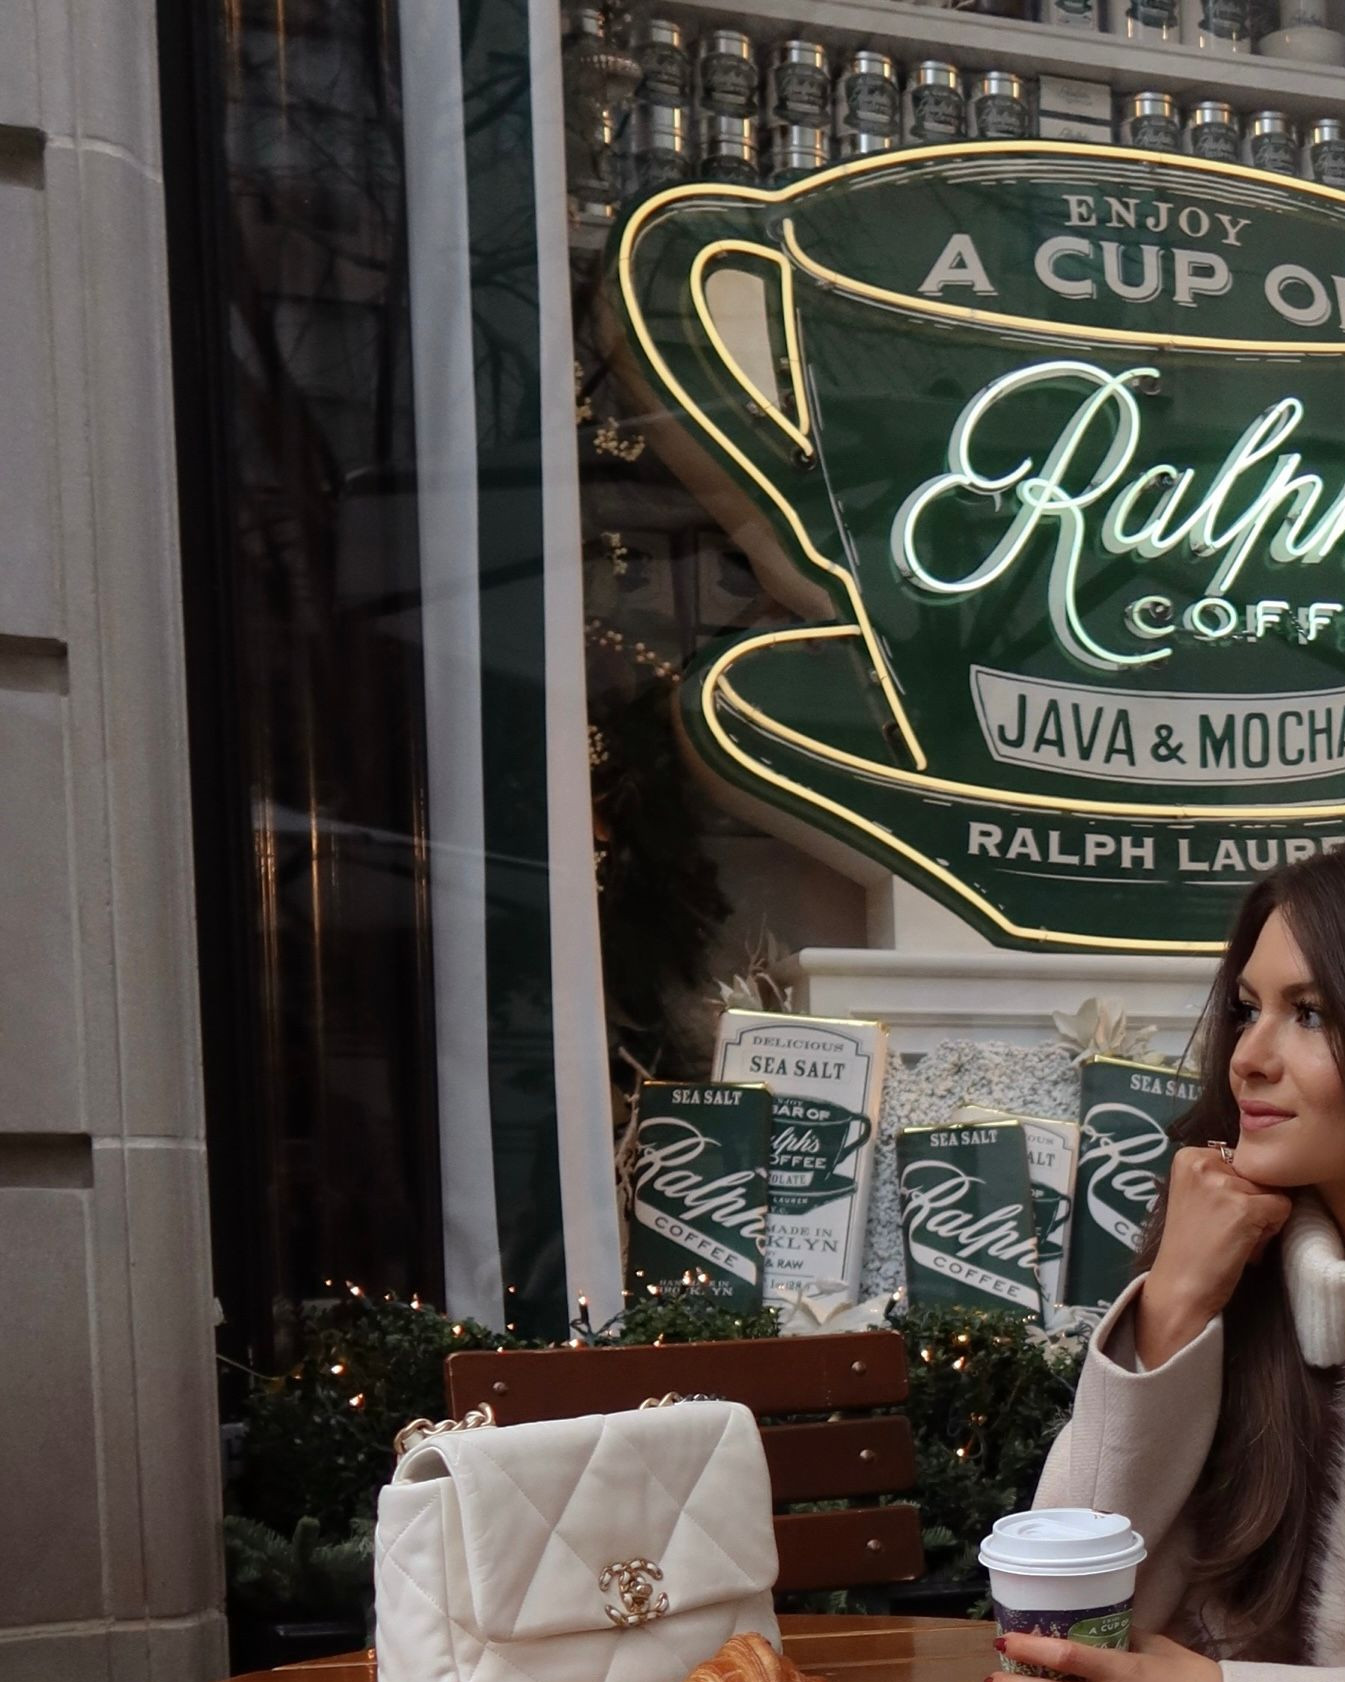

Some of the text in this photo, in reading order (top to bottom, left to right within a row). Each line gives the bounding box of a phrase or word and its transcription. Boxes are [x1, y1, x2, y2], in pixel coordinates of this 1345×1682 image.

[1061, 194, 1252, 247] ENJOY
[917, 233, 998, 297] A
[1033, 235, 1233, 308] CUP
[997, 693, 1136, 766] JAVA
[1150, 723, 1187, 765] &
[967, 821, 1156, 870] RALPH
[752, 1035, 845, 1052] DELICIOUS
[750, 1055, 846, 1080] SEA SALT
[1130, 1073, 1162, 1095] SEA
[672, 1089, 743, 1106] SEA SALT
[806, 1108, 831, 1121] OF
[930, 1129, 998, 1148] SEA SALT
[769, 1153, 827, 1170] OFFEE
[1027, 1151, 1056, 1167] ALT
[815, 1227, 833, 1238] IN
[654, 1216, 739, 1269] COFFEE
[777, 1258, 804, 1270] RAW
[933, 1256, 1021, 1298] COFFEE
[1101, 1621, 1120, 1632] CUP
